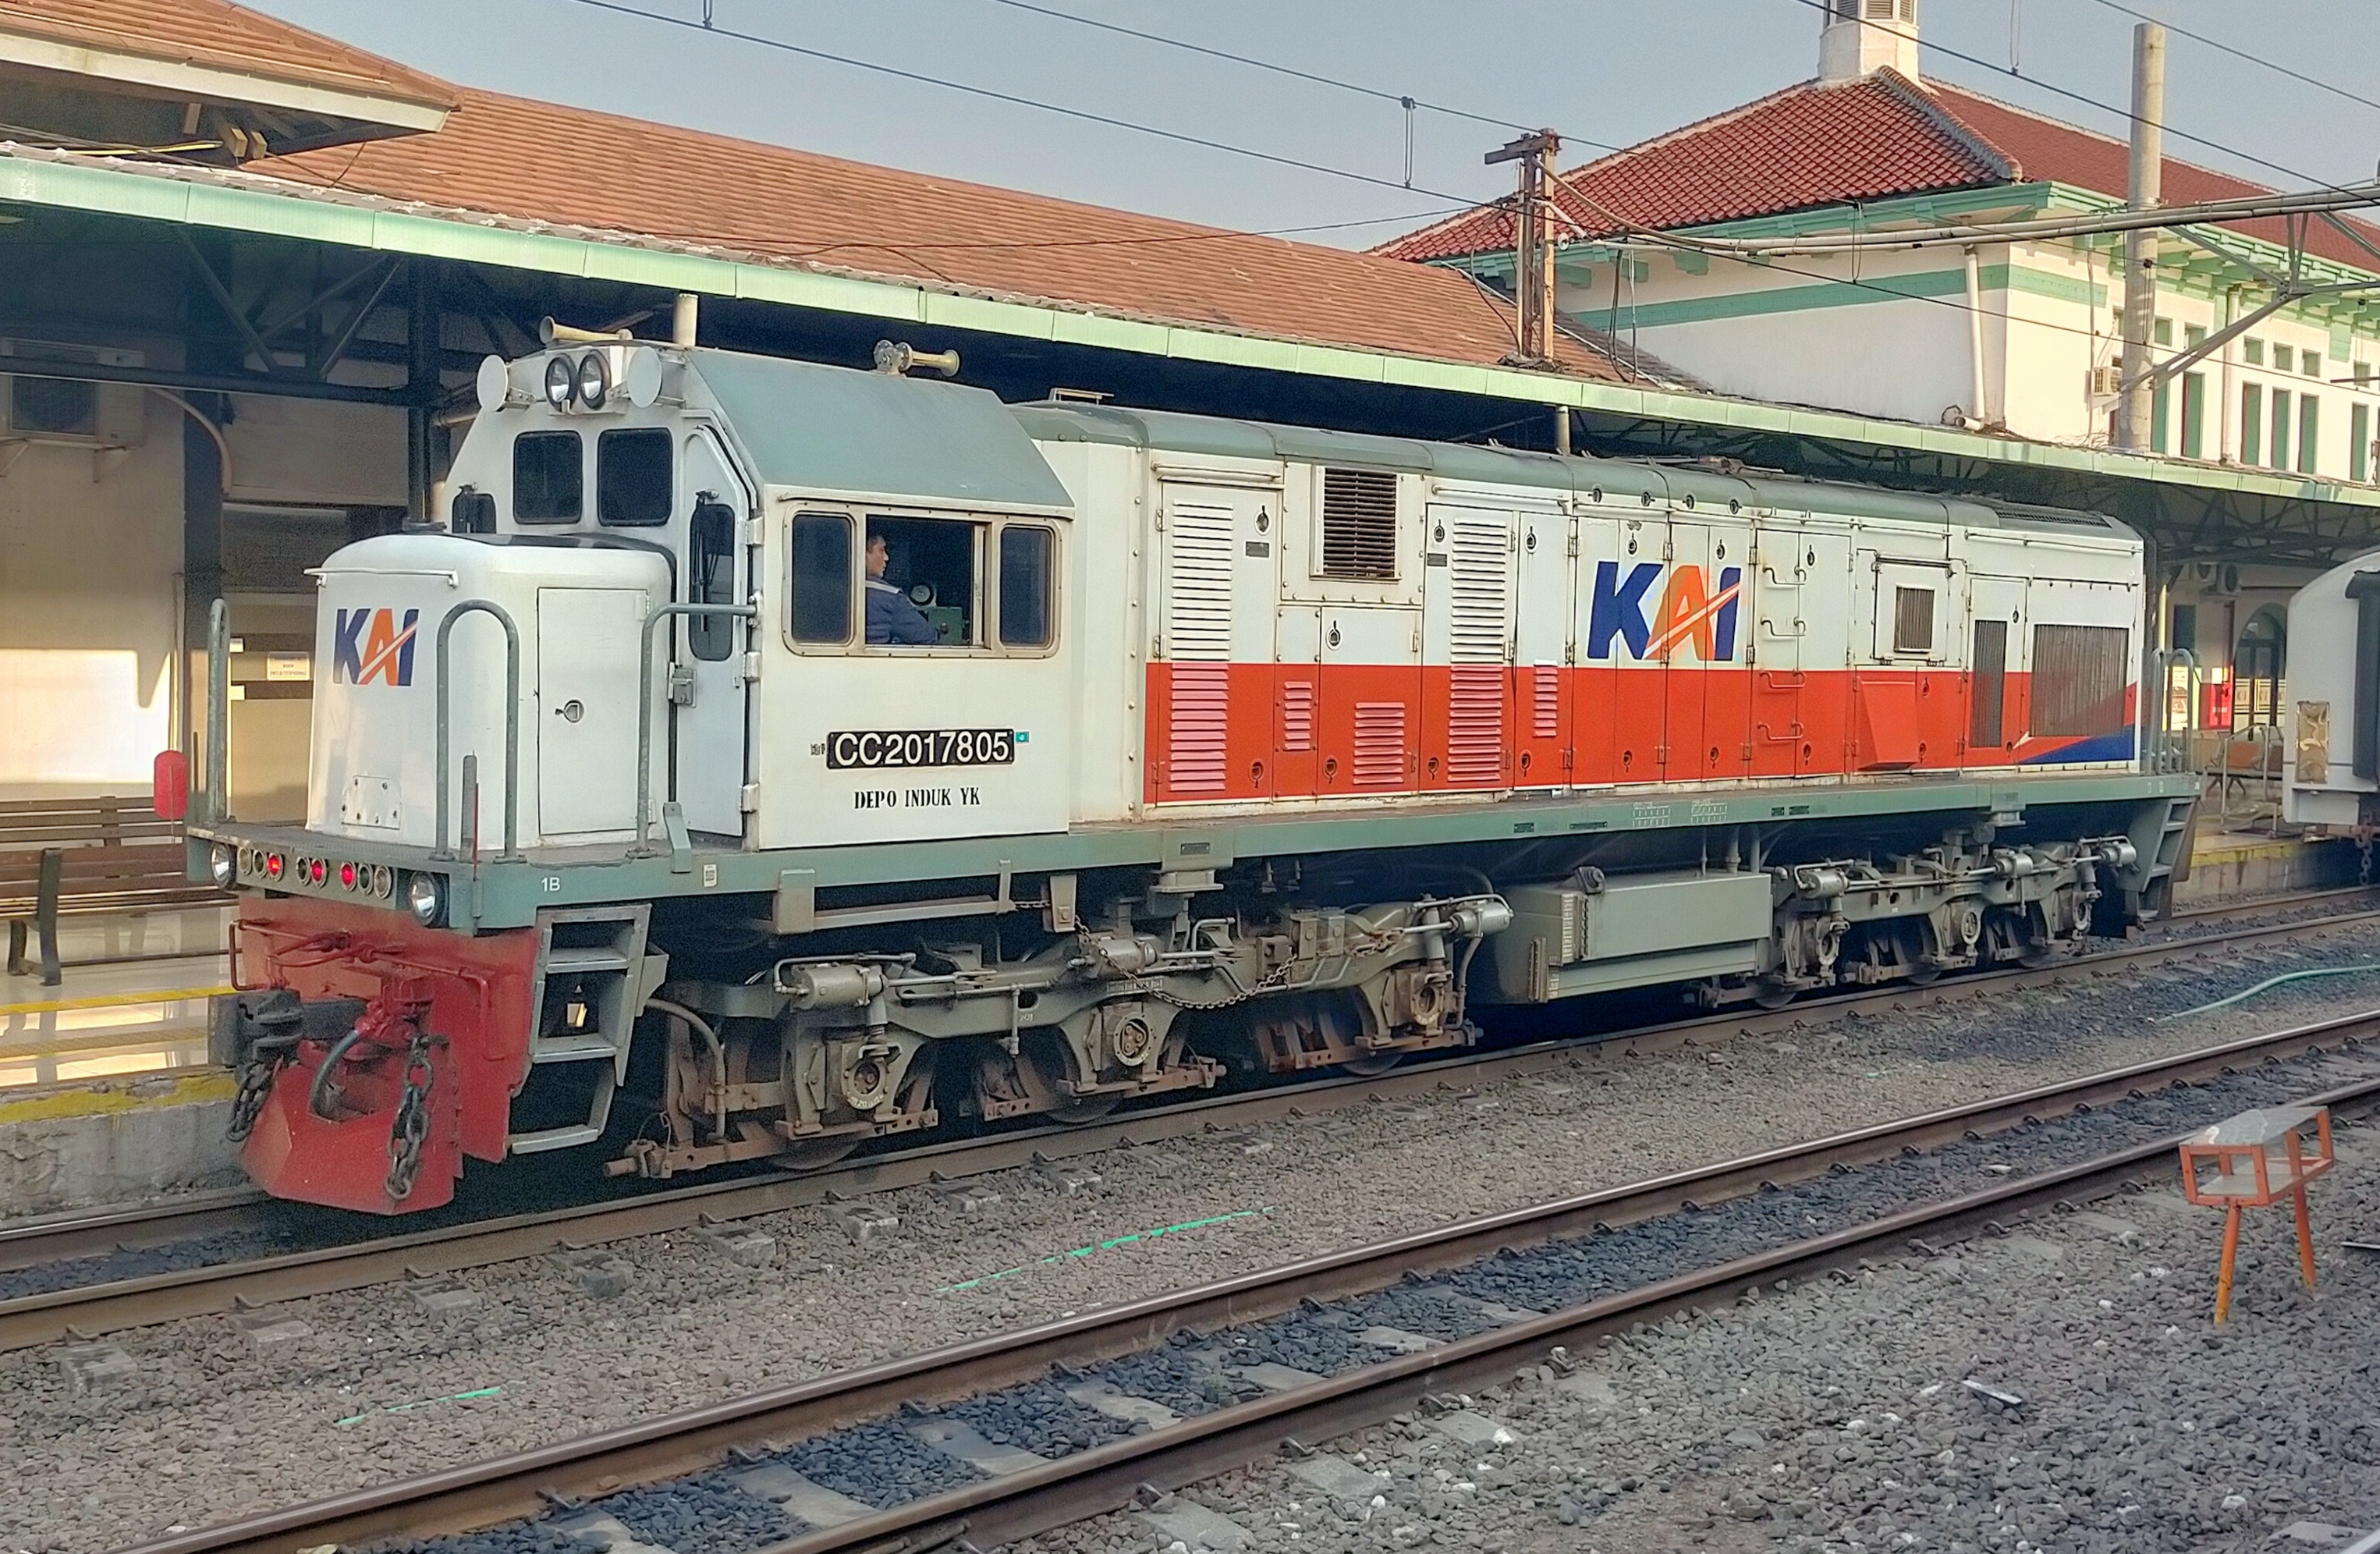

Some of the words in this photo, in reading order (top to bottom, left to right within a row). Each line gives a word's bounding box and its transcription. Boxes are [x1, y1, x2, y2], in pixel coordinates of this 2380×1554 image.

[1587, 561, 1741, 661] KAI
[333, 608, 420, 687] KAI
[834, 731, 1009, 766] CC2017805
[854, 790, 897, 809] DEPO
[905, 788, 951, 807] INDUK
[960, 786, 981, 805] YK
[541, 877, 561, 892] 1B
